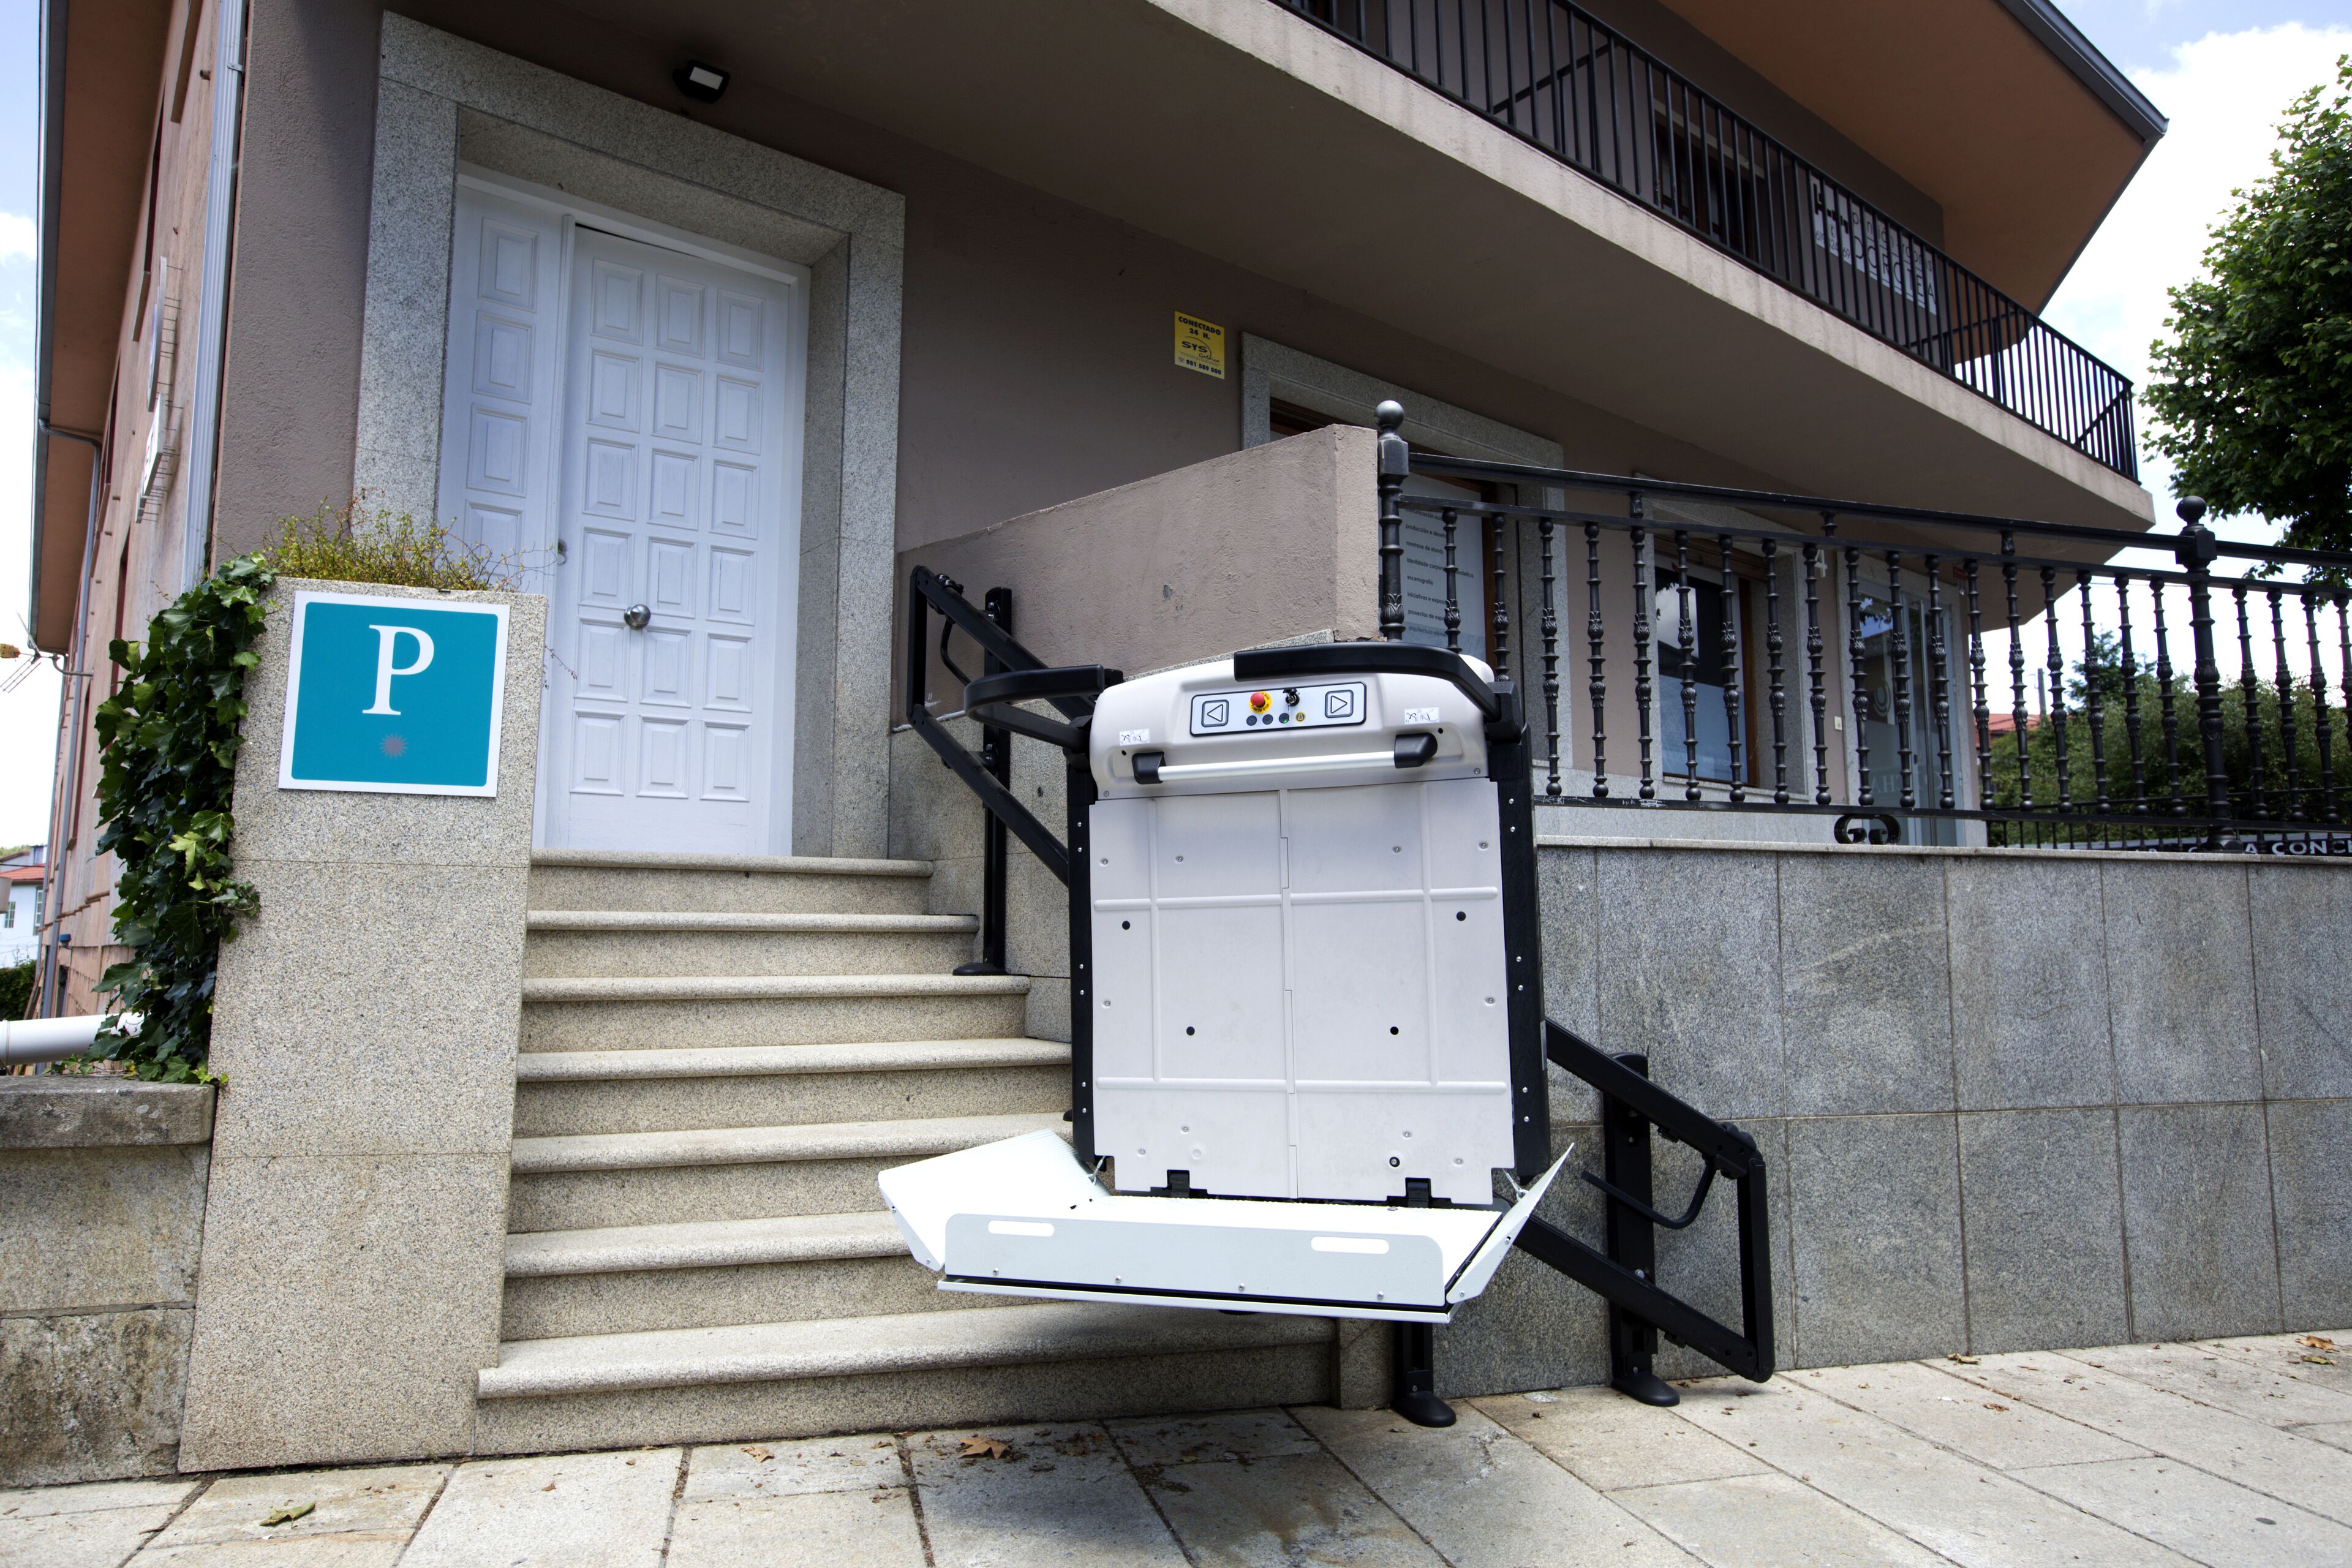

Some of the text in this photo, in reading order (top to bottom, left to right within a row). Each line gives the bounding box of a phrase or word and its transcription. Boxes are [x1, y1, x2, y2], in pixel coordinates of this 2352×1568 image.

[1852, 212, 1895, 249] pnión
[1178, 316, 1221, 336] CONECTADO
[1182, 341, 1208, 353] SYS
[1406, 524, 1429, 535] producción
[1406, 541, 1424, 549] montaxe
[1408, 609, 1428, 618] proxectos
[362, 624, 434, 715] P
